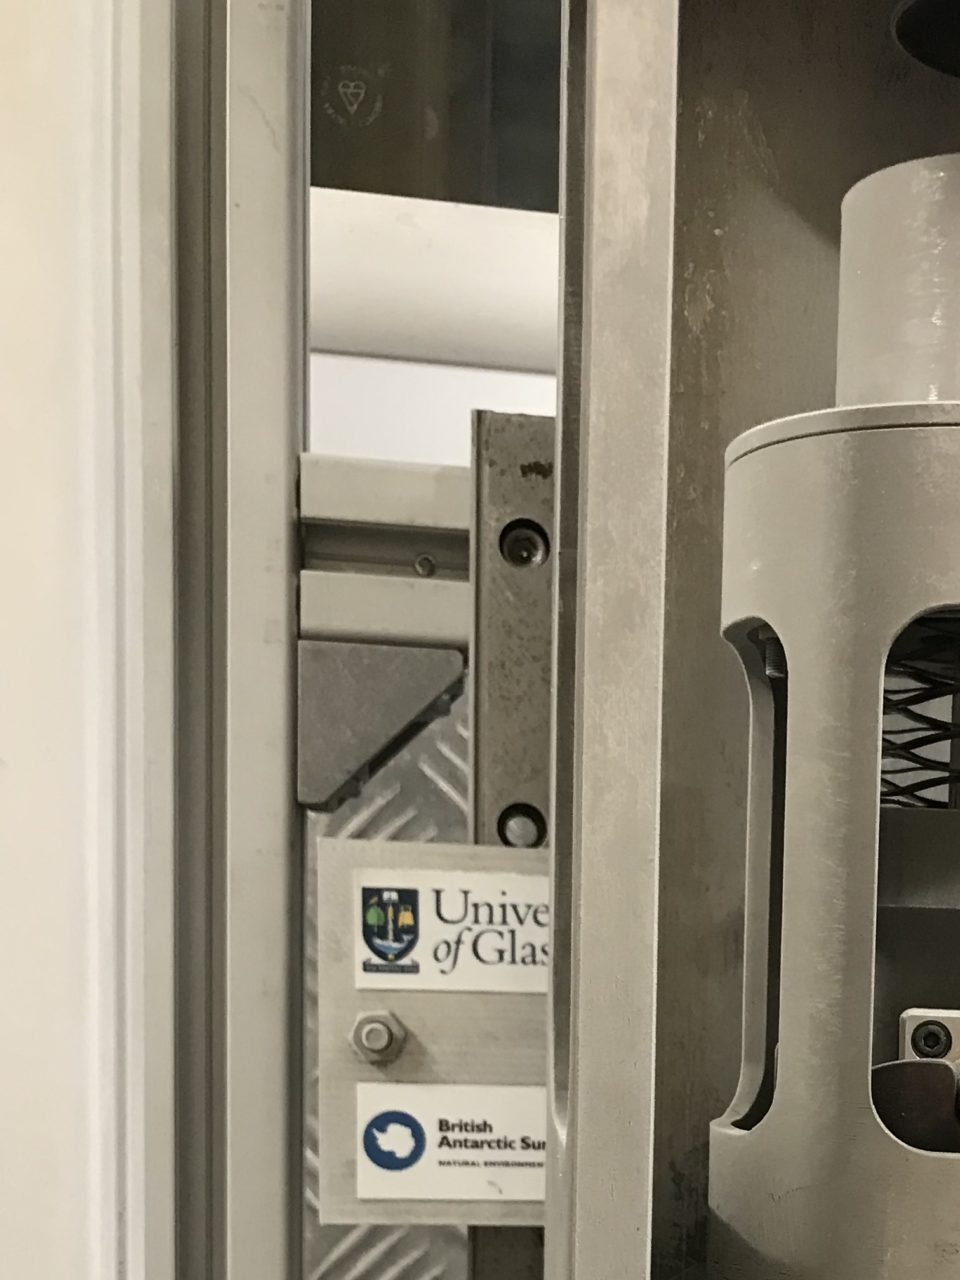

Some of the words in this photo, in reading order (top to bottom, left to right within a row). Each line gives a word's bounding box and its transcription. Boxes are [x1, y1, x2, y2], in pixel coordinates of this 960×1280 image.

[433, 926, 472, 975] of
[438, 1118, 493, 1133] British
[438, 1135, 516, 1150] Antarctic
[438, 1160, 480, 1168] NATURAL
